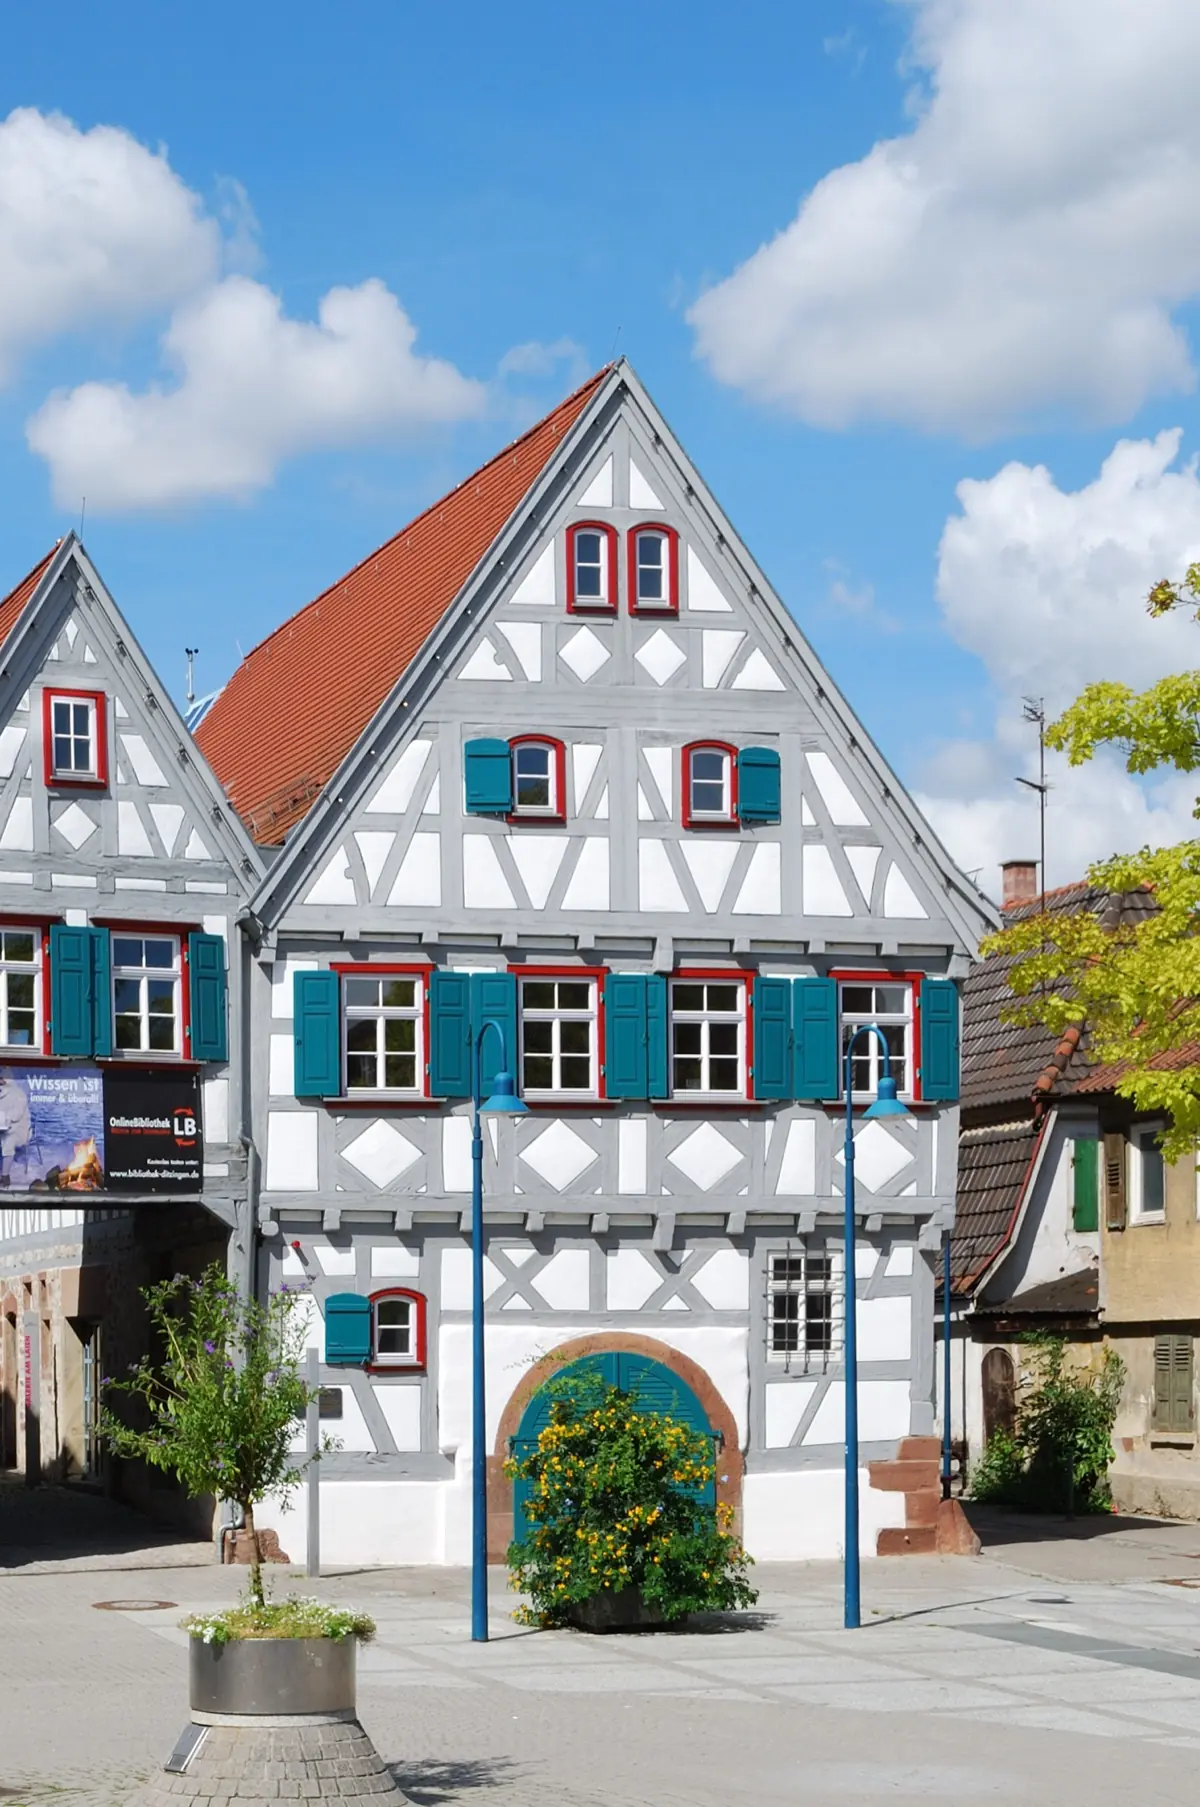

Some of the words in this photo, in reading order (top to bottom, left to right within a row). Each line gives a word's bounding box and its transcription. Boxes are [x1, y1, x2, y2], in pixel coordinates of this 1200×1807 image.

[26, 1074, 78, 1091] Wissen
[83, 1076, 99, 1091] ist
[30, 1092, 56, 1102] immer
[109, 1117, 171, 1128] OnlineBibliothek
[173, 1117, 197, 1136] LB
[109, 1169, 200, 1181] www.bibliothek-ditzingen.de
[25, 1361, 31, 1374] AM
